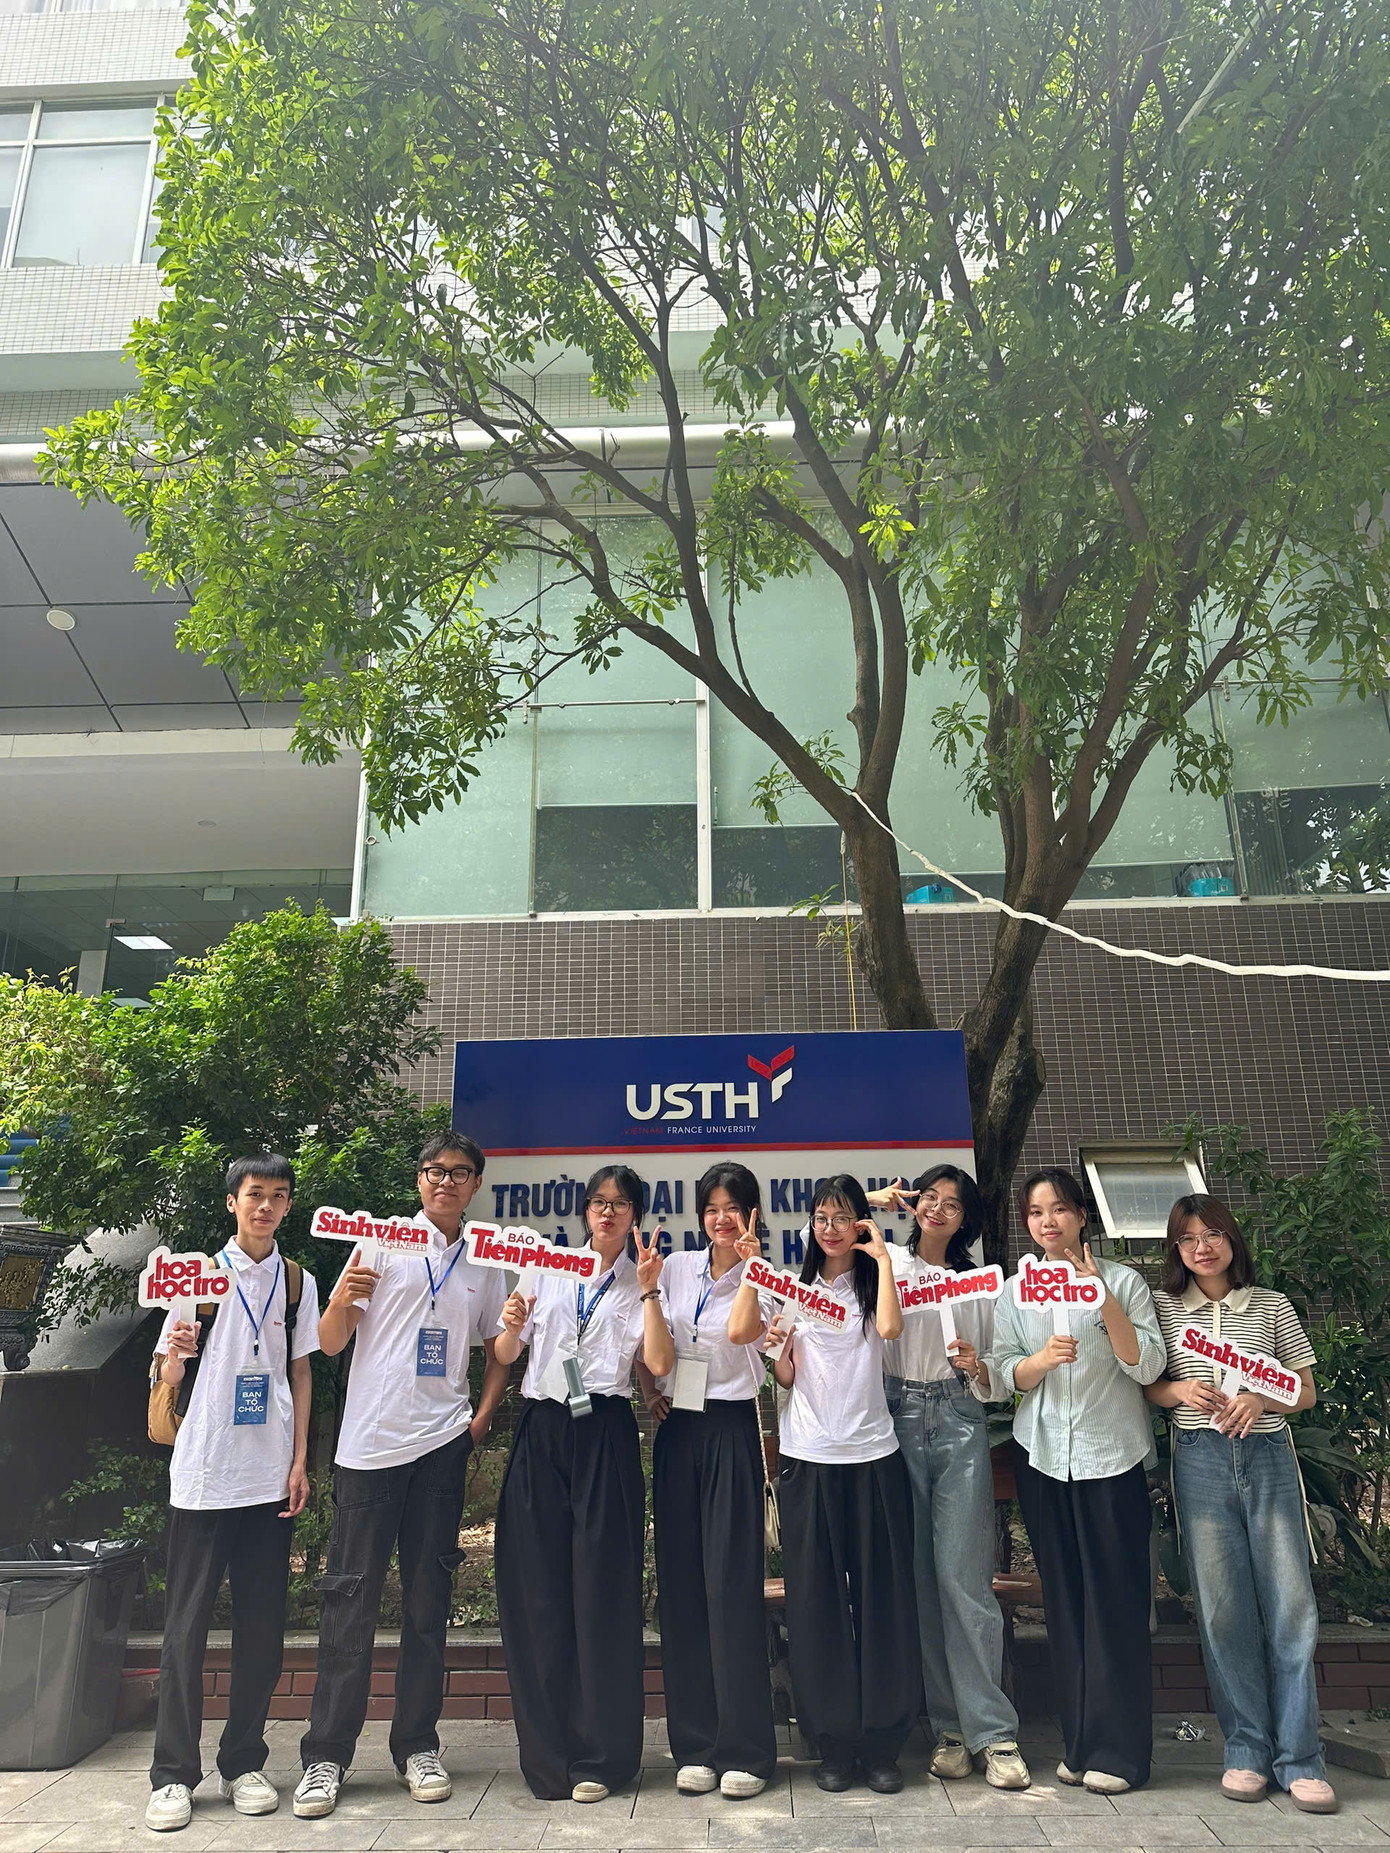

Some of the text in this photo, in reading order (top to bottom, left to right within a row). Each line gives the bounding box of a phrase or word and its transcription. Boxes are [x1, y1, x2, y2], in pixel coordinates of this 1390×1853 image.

[626, 1082, 759, 1120] USTH
[667, 1126, 703, 1134] FRANCE
[706, 1125, 757, 1133] UNIVERSITY
[508, 1232, 534, 1245] BÁO
[155, 1254, 202, 1280] hoa
[1025, 1261, 1069, 1285] hoa
[919, 1272, 941, 1285] BÁO
[424, 1344, 442, 1352] BAN
